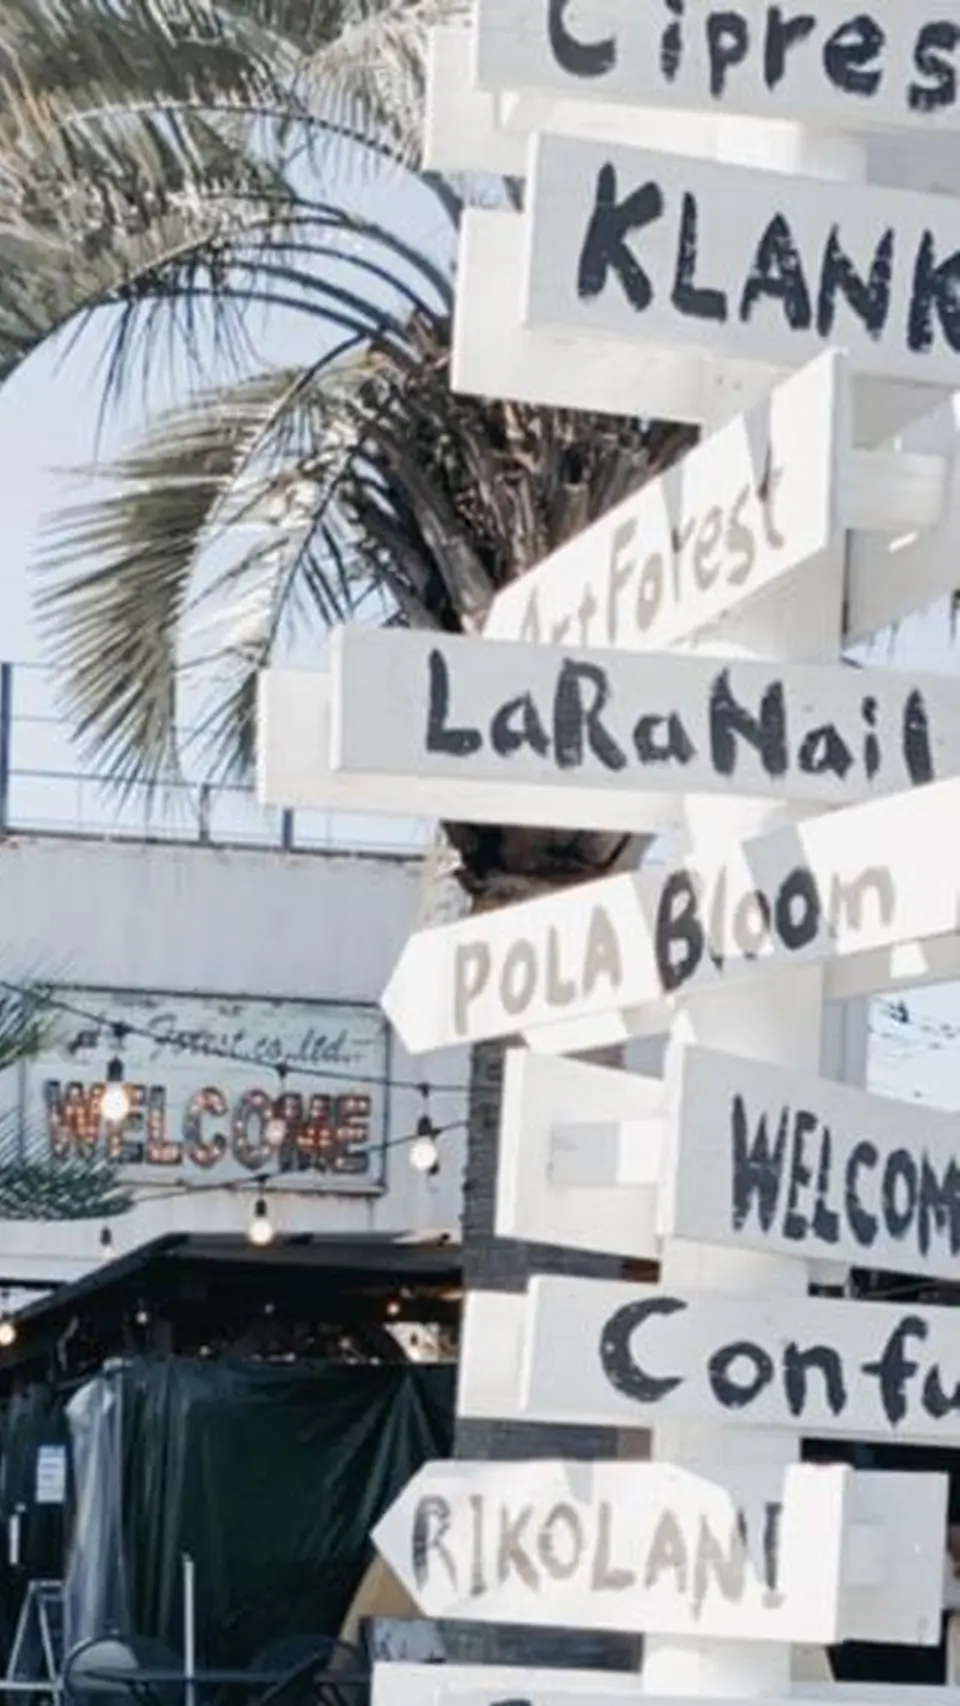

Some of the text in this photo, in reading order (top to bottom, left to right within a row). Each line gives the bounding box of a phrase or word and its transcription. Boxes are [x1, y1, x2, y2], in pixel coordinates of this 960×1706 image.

[576, 162, 960, 354] KLANK
[454, 864, 896, 1036] POLA Bloom
[44, 1079, 372, 1175] WELCOME
[732, 1093, 960, 1258] WELCOM
[599, 1297, 960, 1427] Confu
[411, 1493, 786, 1622] RIKOLANI
